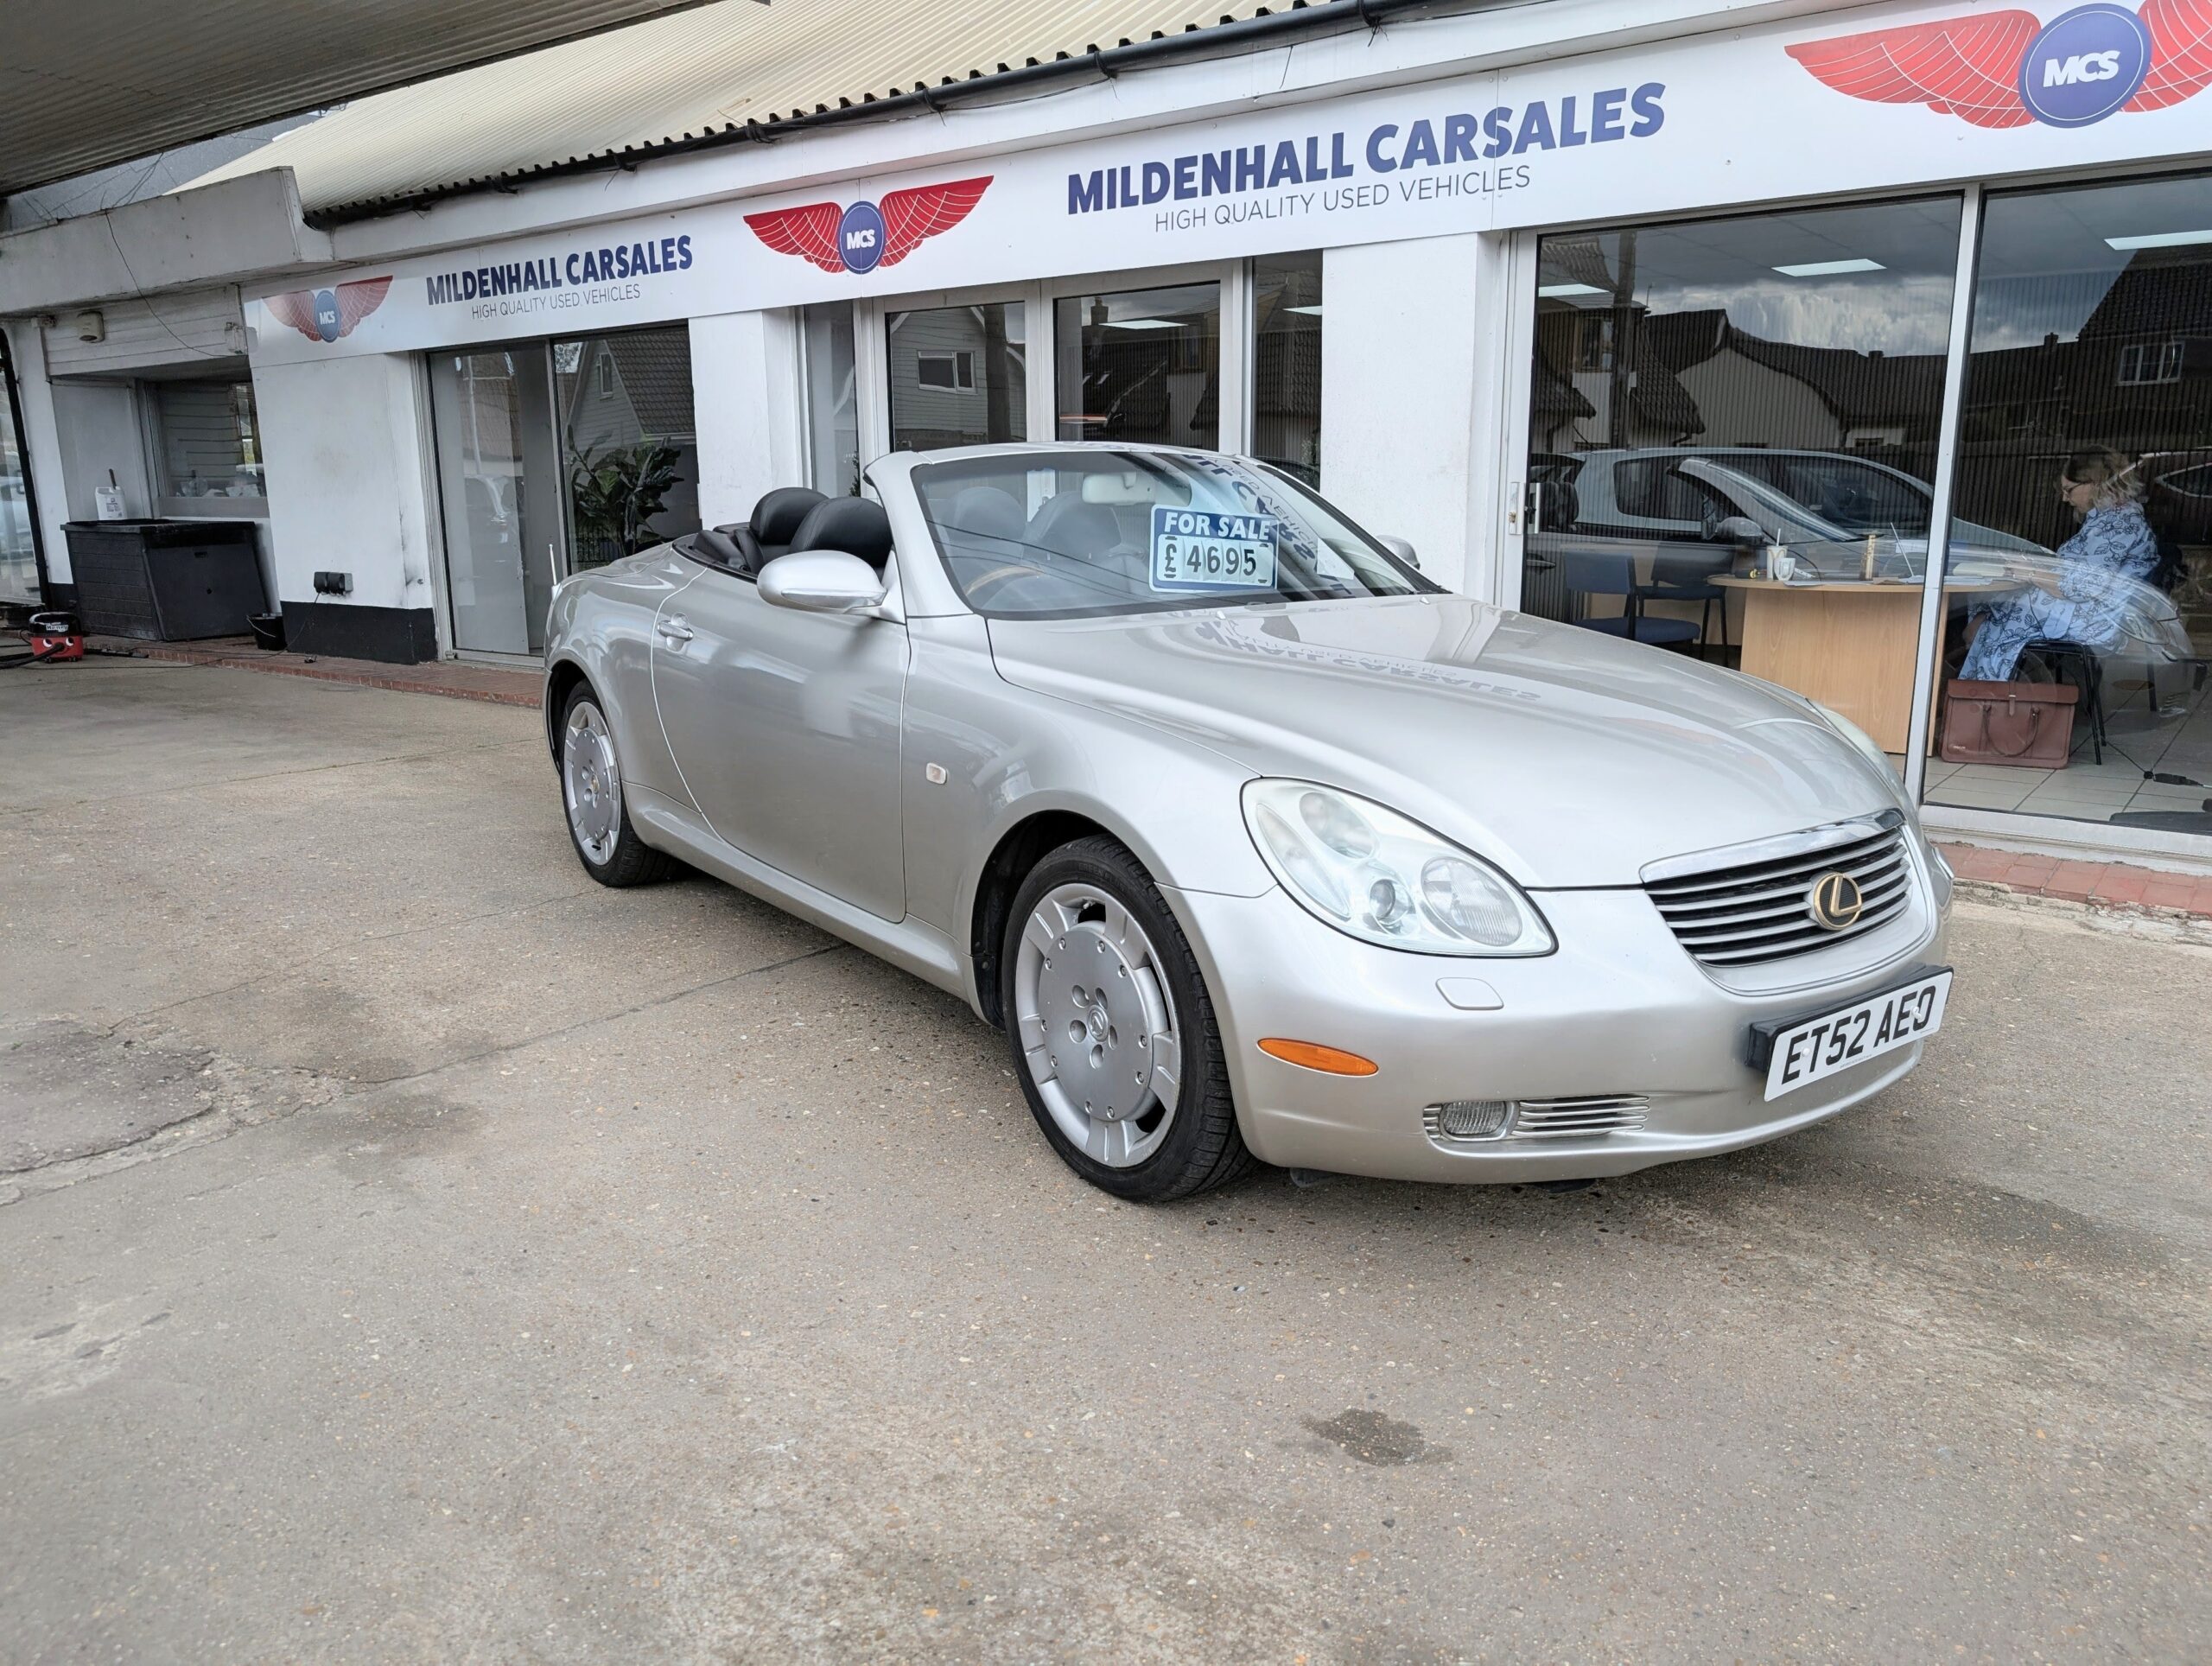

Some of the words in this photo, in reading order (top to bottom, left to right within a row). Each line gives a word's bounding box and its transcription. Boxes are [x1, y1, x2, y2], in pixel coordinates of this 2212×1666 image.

[2043, 50, 2120, 87] MCS
[1068, 131, 1354, 215] MILDENHALL
[1366, 82, 1666, 174] CARSALES
[1155, 207, 1206, 232] HIGH
[1214, 192, 1315, 225] QUALITY
[1324, 184, 1389, 211] USED
[1399, 165, 1530, 202] VEHICLES
[846, 229, 875, 250] MCS
[426, 257, 562, 305] MILDENHALL
[566, 234, 693, 285] CARSALES
[319, 311, 336, 325] MCS
[472, 302, 497, 319] HIGH
[499, 296, 546, 315] QUALITY
[550, 292, 580, 309] USED
[582, 283, 640, 305] VEHICLES
[1164, 512, 1211, 536] FOR
[1217, 517, 1271, 541] SALE
[1781, 1009, 1872, 1085] ET52
[1873, 985, 1936, 1047] AEO
